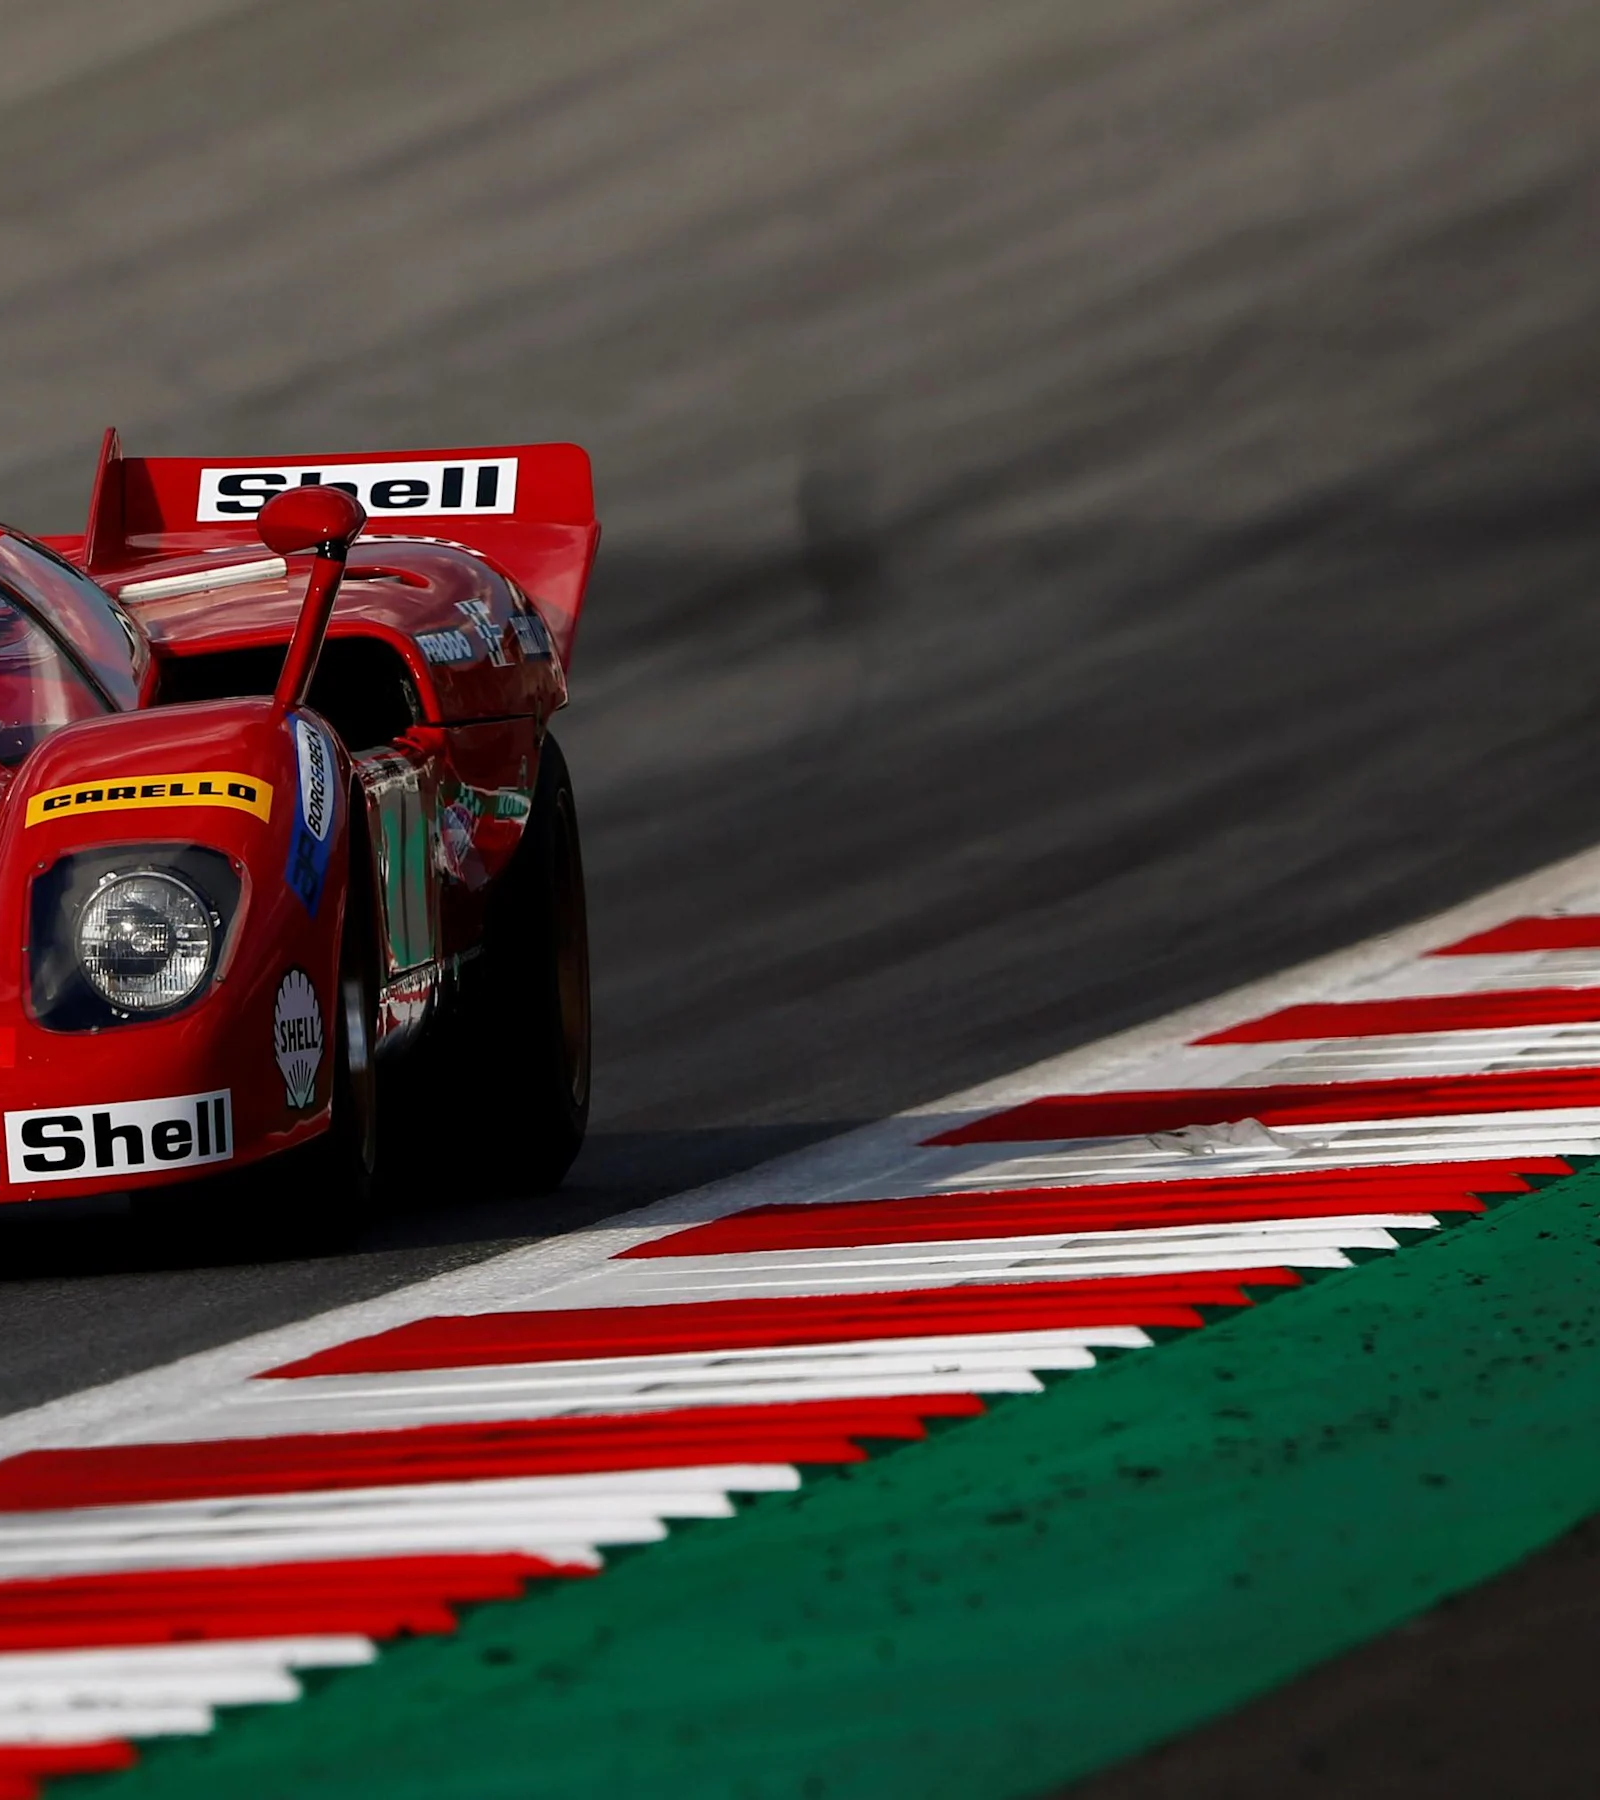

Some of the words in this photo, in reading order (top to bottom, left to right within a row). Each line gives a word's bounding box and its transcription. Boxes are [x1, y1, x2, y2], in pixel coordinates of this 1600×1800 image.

[415, 629, 473, 662] FERODO
[43, 783, 257, 811] CARELLO
[280, 1016, 318, 1053] SHELL
[21, 1097, 228, 1173] Shell
